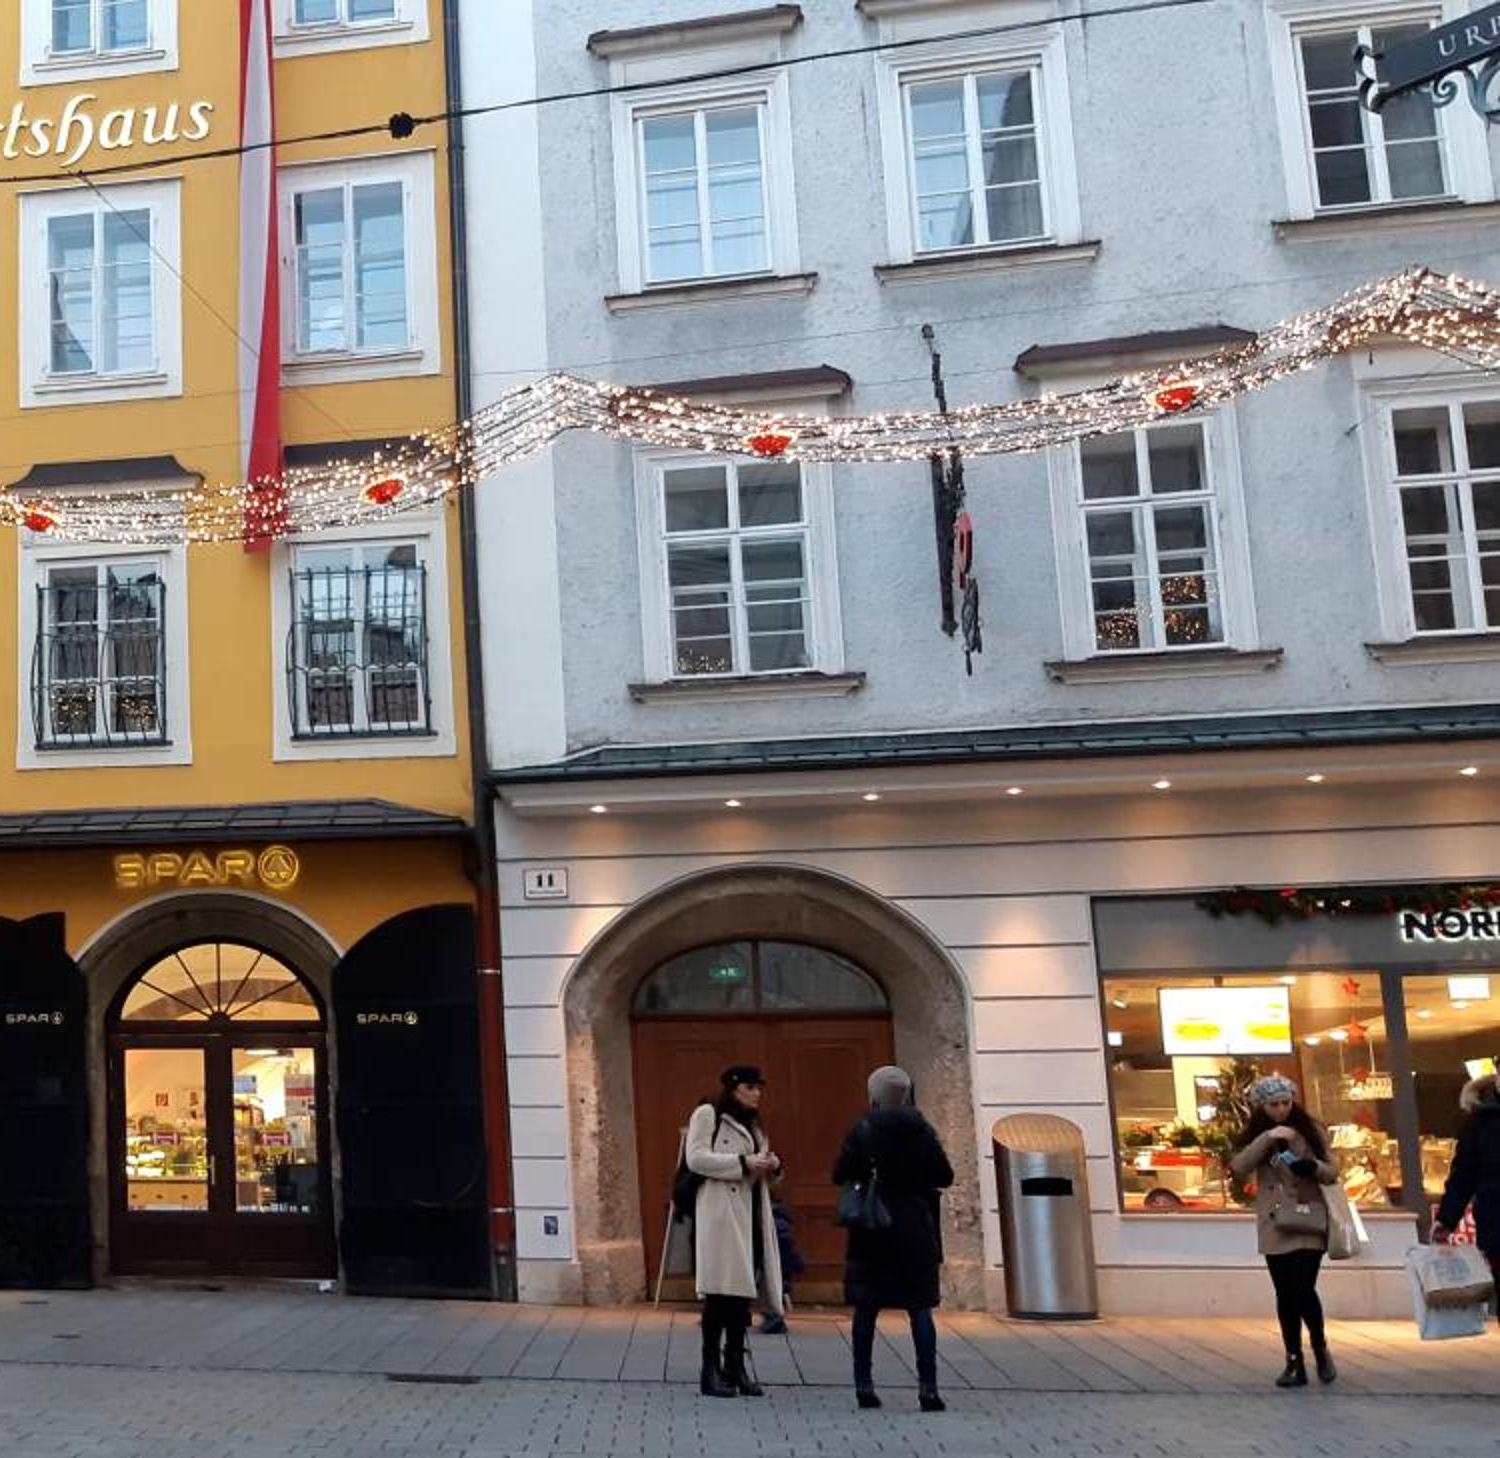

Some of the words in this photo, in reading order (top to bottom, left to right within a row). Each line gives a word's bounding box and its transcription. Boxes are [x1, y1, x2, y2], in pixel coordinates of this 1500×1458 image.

[113, 850, 254, 888] SPAR
[536, 873, 554, 888] 11
[1401, 909, 1500, 941] NOR
[5, 1012, 49, 1024] SPAR
[356, 1012, 403, 1025] SPAR
